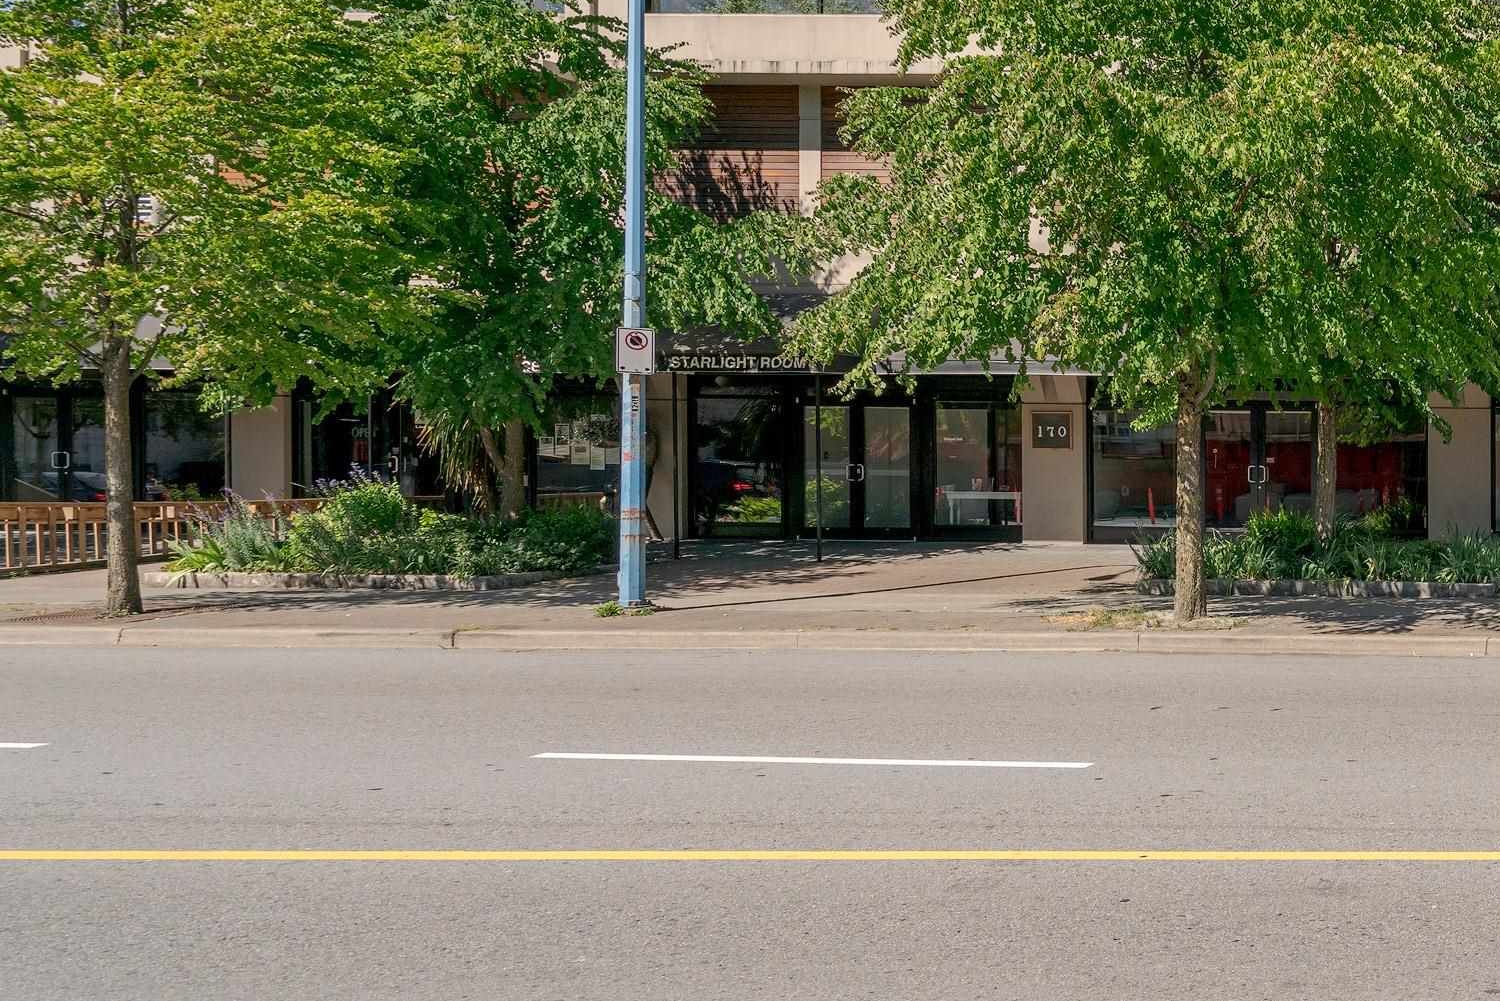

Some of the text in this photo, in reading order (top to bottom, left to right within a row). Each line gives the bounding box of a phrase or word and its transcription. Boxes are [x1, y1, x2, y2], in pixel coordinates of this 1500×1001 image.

[671, 355, 806, 369] STARLIGHT ROOM
[1037, 425, 1067, 438] 170
